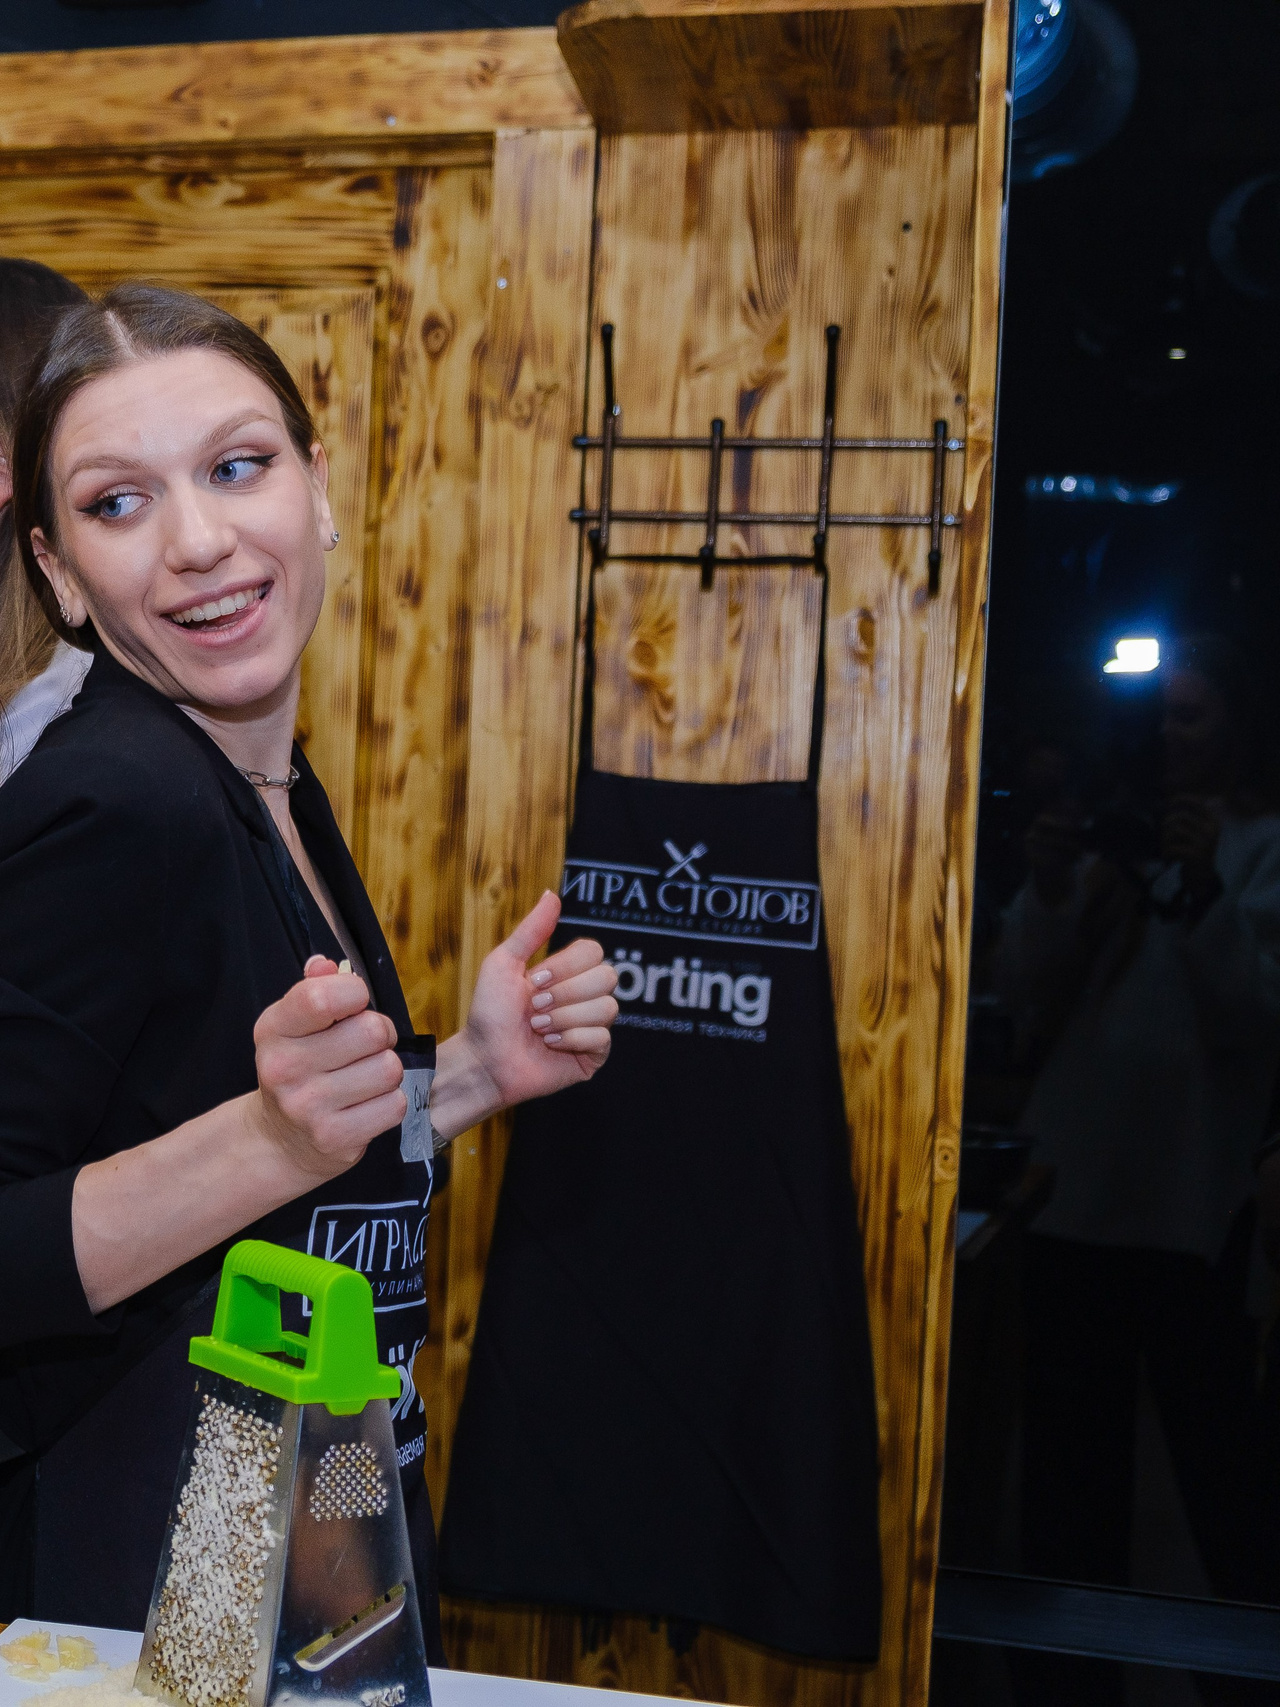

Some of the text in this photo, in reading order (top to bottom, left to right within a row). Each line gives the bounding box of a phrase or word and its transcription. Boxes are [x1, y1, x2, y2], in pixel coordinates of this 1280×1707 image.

[562, 868, 811, 926] ИГРА СТОЛОВ
[604, 948, 771, 1027] örting
[396, 1434, 426, 1468] ваемая
